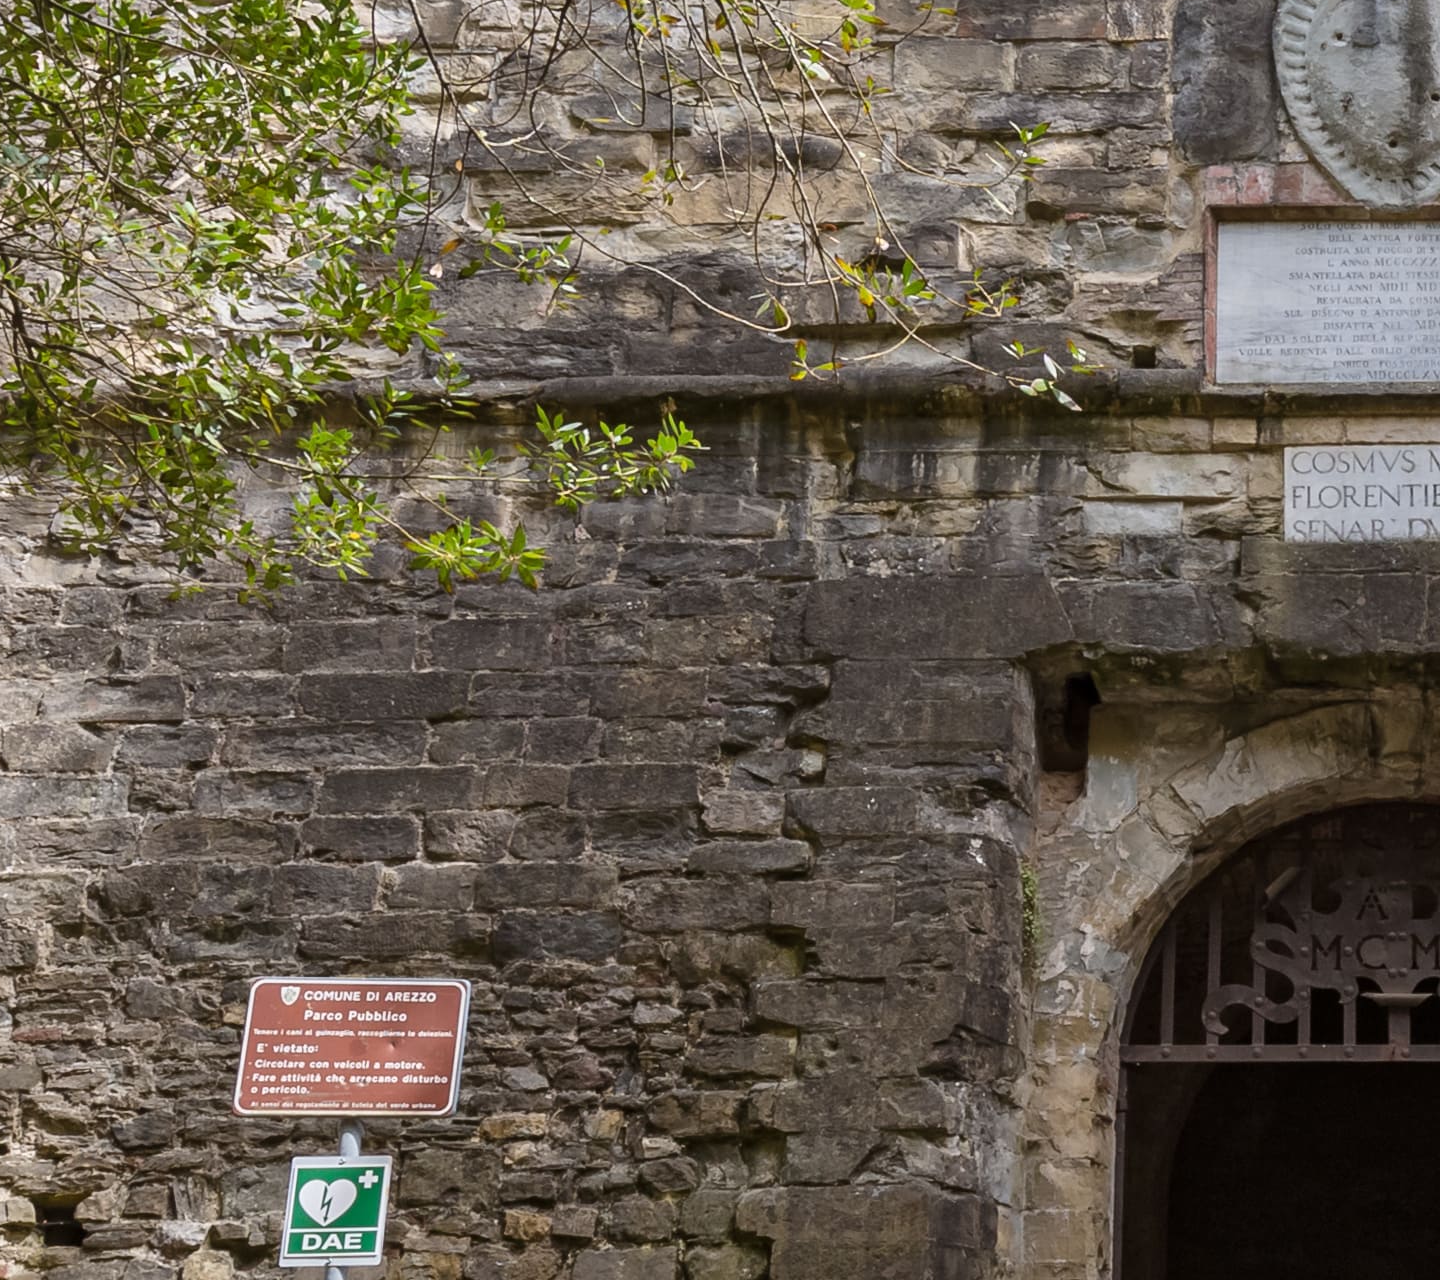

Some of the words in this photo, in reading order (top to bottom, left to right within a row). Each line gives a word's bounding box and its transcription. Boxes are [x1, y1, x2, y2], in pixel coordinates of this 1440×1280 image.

[1361, 233, 1401, 242] ANTICA
[1295, 247, 1350, 256] COSTRUITA
[1353, 247, 1372, 256] SUL
[1416, 247, 1426, 256] DI
[1340, 258, 1370, 267] ANNO
[1288, 271, 1364, 280] SMANTELLATA
[1368, 271, 1401, 280] DAGLI
[1405, 271, 1440, 280] STESSI
[1309, 283, 1341, 292] NEGLI
[1346, 283, 1373, 292] ANNI
[1316, 296, 1382, 305] RESTAURATA
[1389, 296, 1403, 305] DA
[1311, 308, 1354, 318] DISEGNO
[1374, 308, 1421, 318] ANTONIO
[1426, 308, 1440, 318] DA
[1323, 321, 1376, 330] DISFATTA
[1264, 334, 1286, 343] DAI
[1292, 334, 1343, 343] SOLDATI
[1352, 334, 1387, 343] DELLA
[1238, 346, 1273, 356] VOLLE
[1333, 359, 1369, 368] ENRICO
[304, 990, 360, 1003] COMUNE
[366, 990, 380, 1003] DI
[384, 990, 437, 1003] AREZZO
[303, 1009, 343, 1022] Parco
[348, 1009, 408, 1022] Pubblico
[286, 1029, 303, 1037] cani
[304, 1029, 313, 1037] al
[273, 1043, 320, 1054] vietato:
[254, 1059, 306, 1069] Circolare
[309, 1061, 330, 1069] con
[334, 1059, 370, 1070] veicoli
[373, 1062, 382, 1070] a
[384, 1059, 427, 1070] motore.
[252, 1073, 277, 1082] Fare
[325, 1074, 346, 1083] che
[349, 1076, 399, 1085] arrecano
[402, 1074, 449, 1085] disturbo
[250, 1086, 259, 1094] o
[261, 1085, 311, 1096] pericolo.
[301, 1232, 362, 1251] DAE
